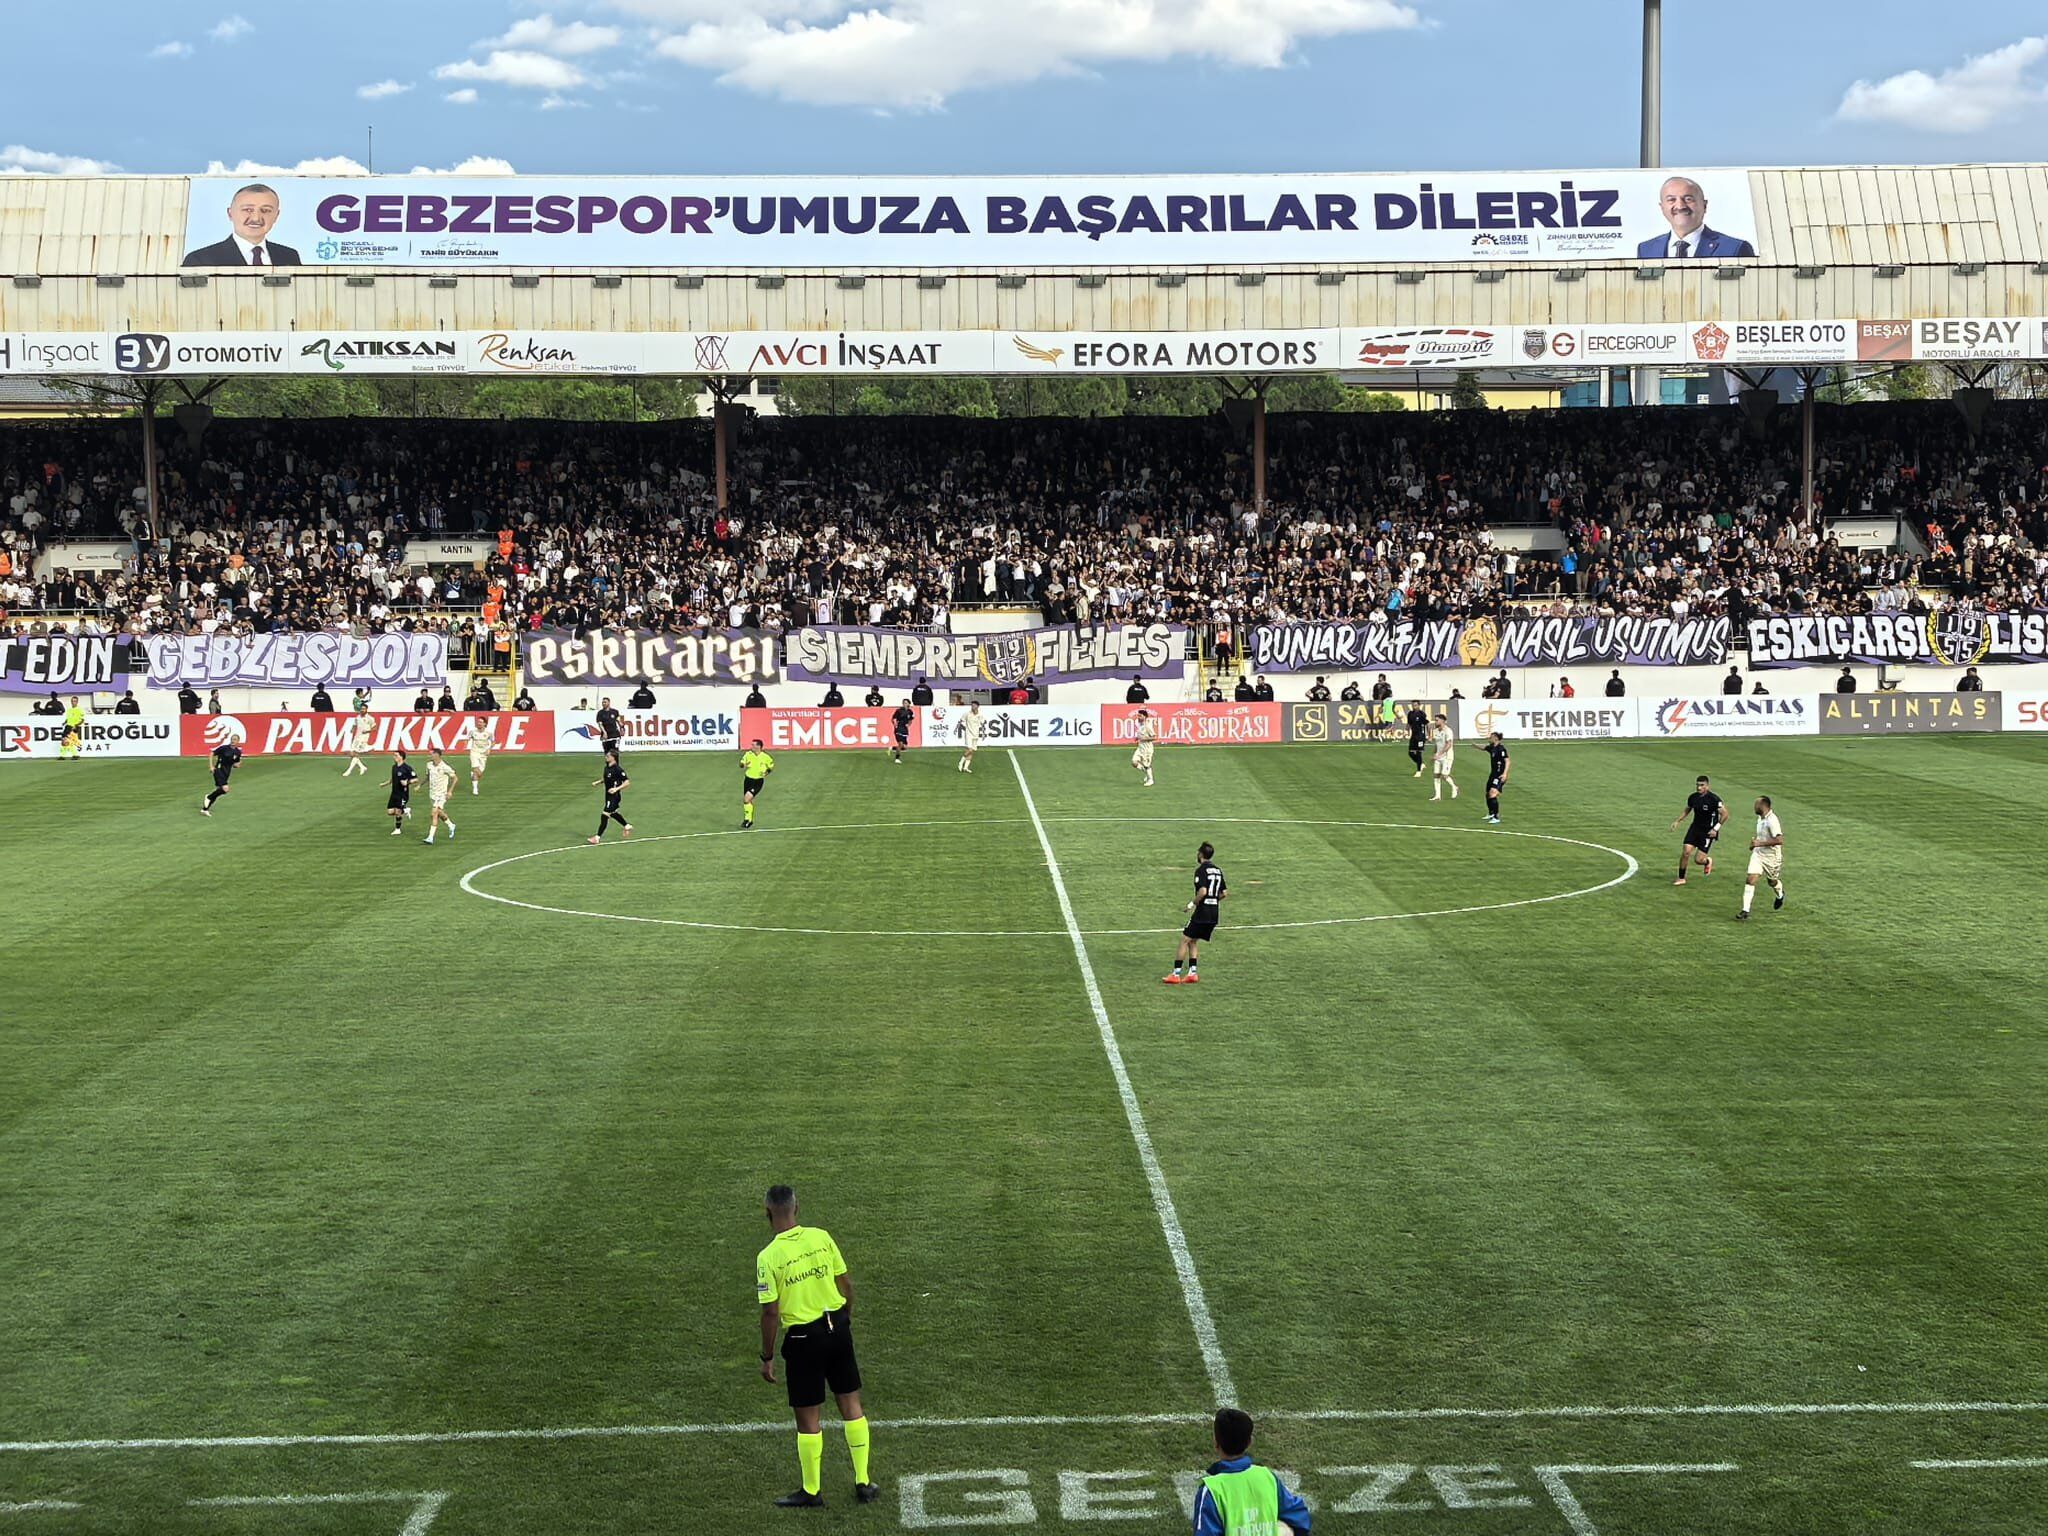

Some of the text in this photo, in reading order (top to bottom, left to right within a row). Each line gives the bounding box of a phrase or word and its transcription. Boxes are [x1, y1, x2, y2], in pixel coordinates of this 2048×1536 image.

[316, 181, 1622, 241] GEBZESPOR’UMUZA BAŞARILAR DİLERİZ
[1588, 336, 1677, 351] ERCEGROUP
[1736, 325, 1846, 348] BEŞLER OTO
[1863, 324, 1911, 339] BEŞAY
[1921, 321, 2021, 349] BEŞAY
[22, 333, 100, 368] İnşaat
[178, 342, 283, 363] OTOMOTİV
[333, 341, 456, 356] ATIKSAN
[478, 334, 577, 367] Renksan
[839, 333, 942, 370] İNŞAAT
[1074, 341, 1318, 366] EFORA MOTORS
[1922, 350, 1970, 359] MOTORLU
[149, 633, 446, 686] GEBZESPOR
[1256, 624, 1358, 670] BUNLAR
[1686, 698, 1805, 718] ASLANTAŞ
[1826, 697, 1987, 720] ALTINTAŞ
[618, 713, 735, 738] hidrotek
[1197, 715, 1270, 743] SOFRASI
[1207, 874, 1222, 897] 77
[899, 1464, 1534, 1530] GEZE
